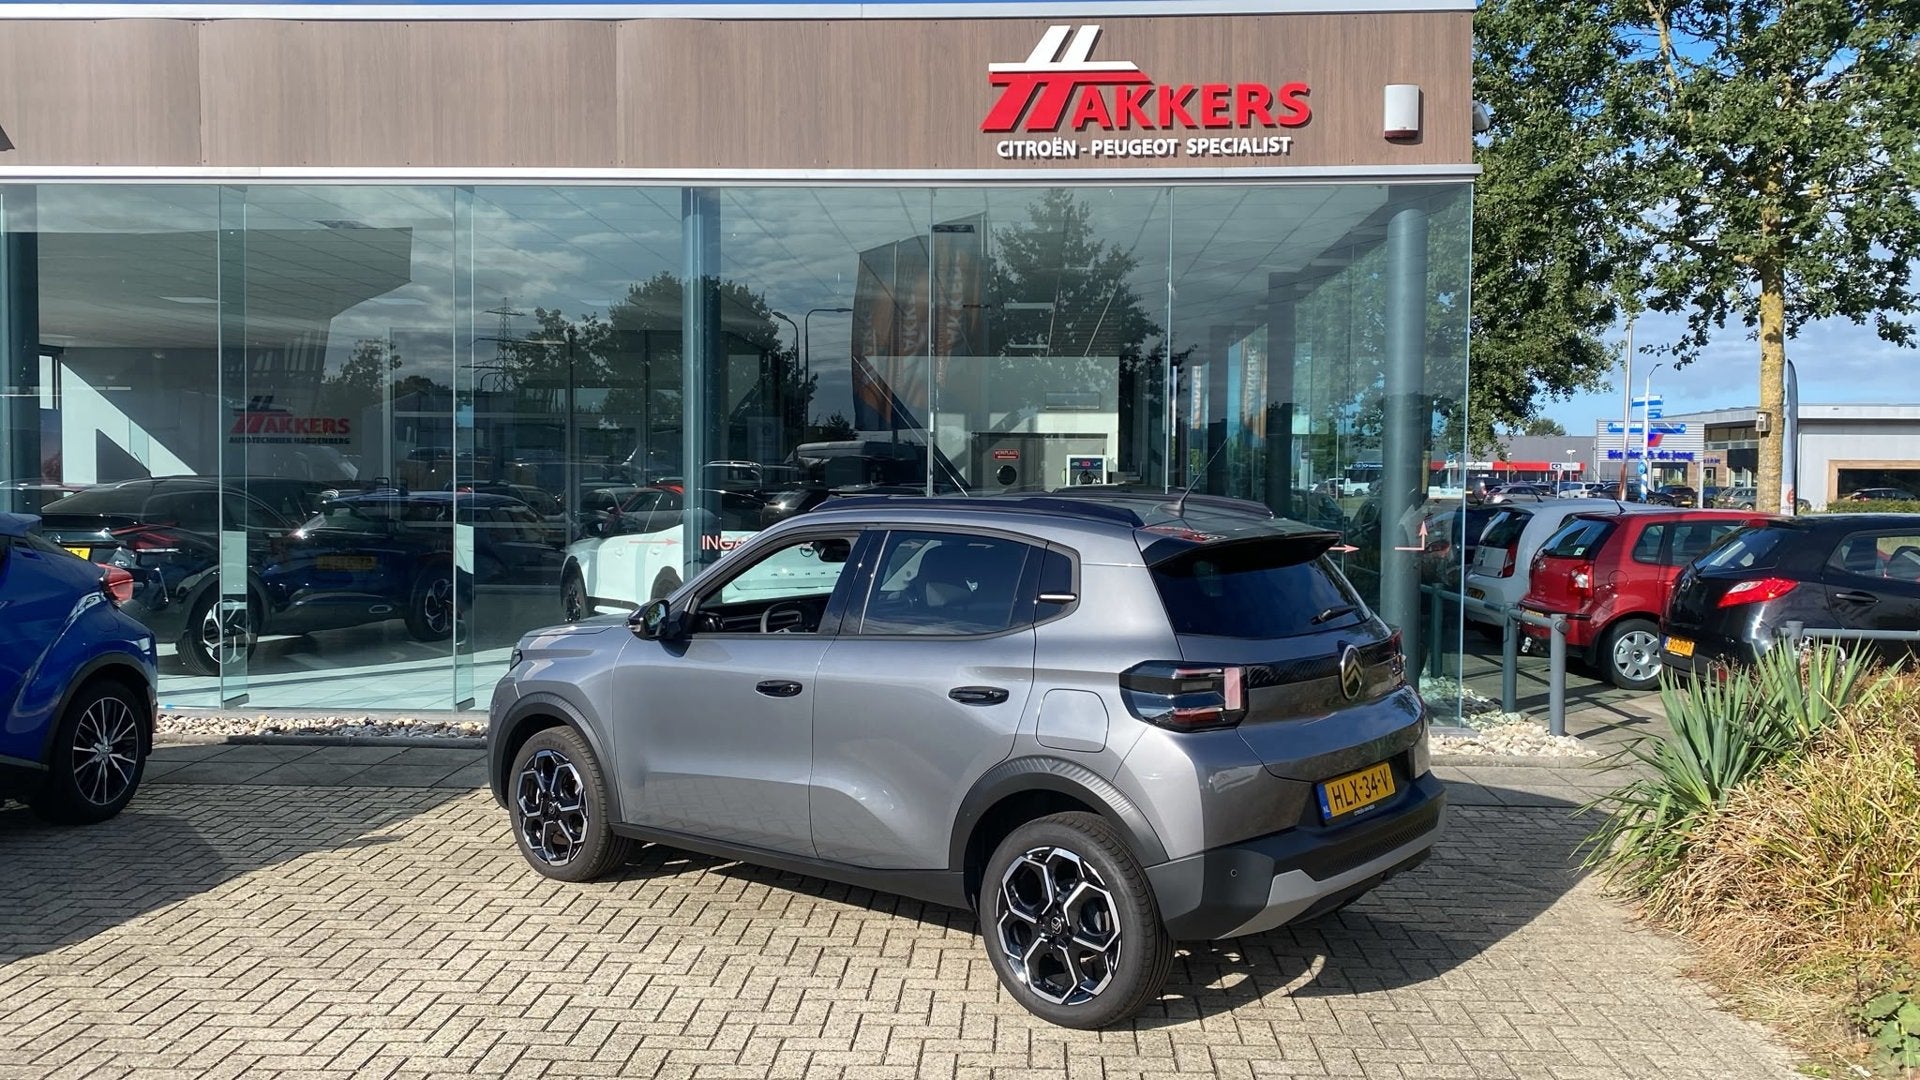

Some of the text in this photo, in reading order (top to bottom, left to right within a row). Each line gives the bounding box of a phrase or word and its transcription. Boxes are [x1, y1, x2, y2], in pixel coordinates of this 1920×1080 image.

[981, 25, 1312, 131] HAKKERS
[996, 137, 1076, 157] CITROËN
[1091, 138, 1178, 156] PEUGEOT
[1186, 137, 1292, 154] SPECIALIST
[702, 535, 746, 550] INGA
[1330, 768, 1389, 811] HLX-34-V
